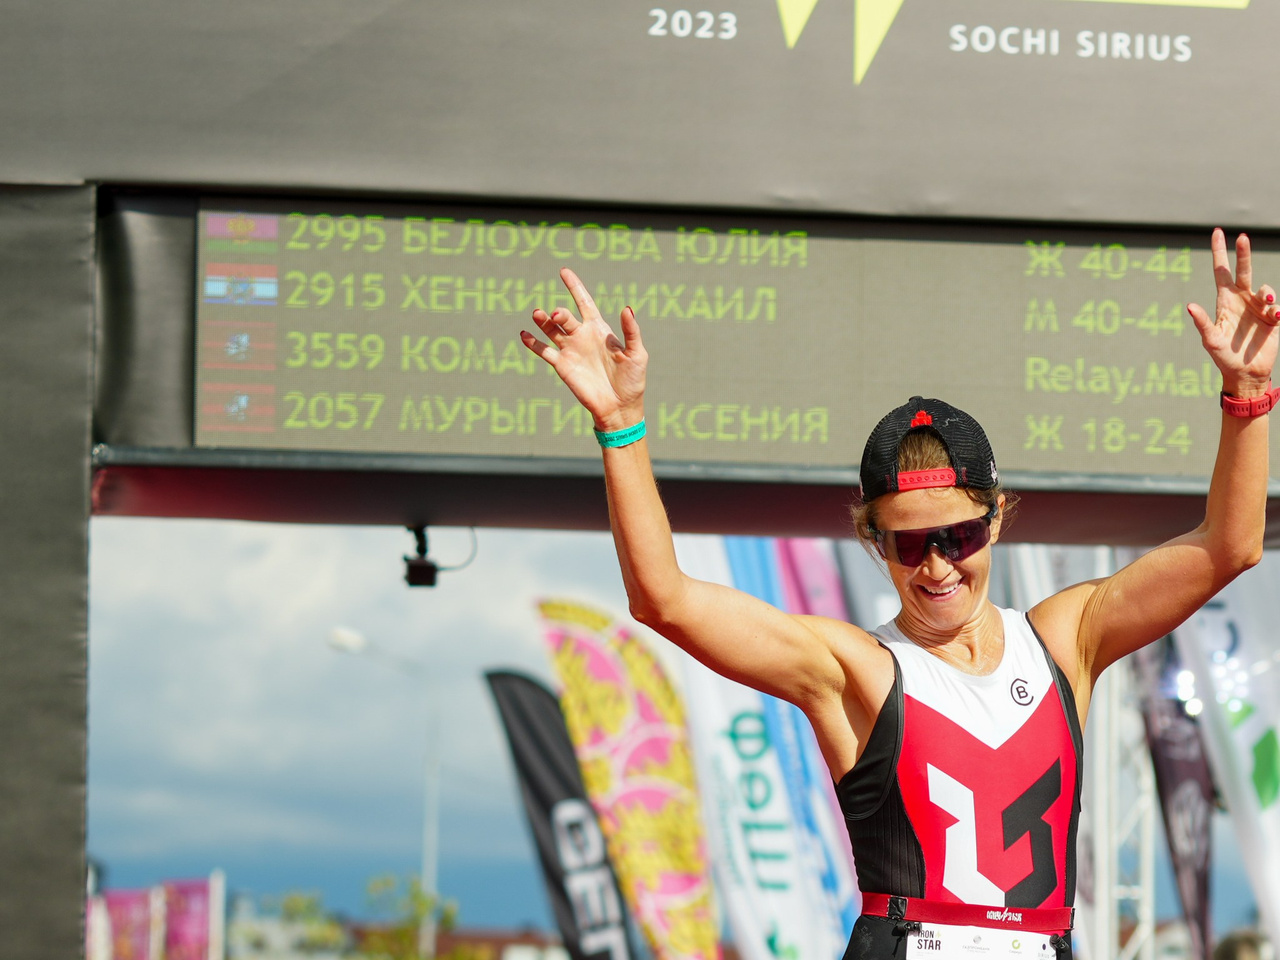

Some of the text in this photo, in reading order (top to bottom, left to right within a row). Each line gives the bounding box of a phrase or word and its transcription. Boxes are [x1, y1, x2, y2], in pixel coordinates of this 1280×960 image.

[648, 9, 737, 39] 2023
[949, 25, 1192, 62] SOCHI SIRIUS
[284, 212, 386, 252] 2995
[402, 217, 662, 262] БЕЛОУСОВА
[676, 226, 808, 267] ЮЛИЯ
[1024, 240, 1066, 278] Ж
[1079, 243, 1192, 282] 40-44
[284, 270, 386, 311] 2915
[401, 273, 577, 314] ХЕНКИН
[594, 281, 777, 322] МИХАИЛ
[1024, 298, 1060, 333] М
[1071, 300, 1185, 336] 40-44
[285, 331, 385, 370] 3559
[402, 334, 563, 387] КОМА
[283, 391, 385, 430] 2057
[398, 395, 594, 436] МУРЫГИ
[657, 402, 828, 443] КСЕНИЯ
[1024, 414, 1065, 450] Ж
[1081, 416, 1192, 455] 18-24
[917, 938, 942, 951] STAR
